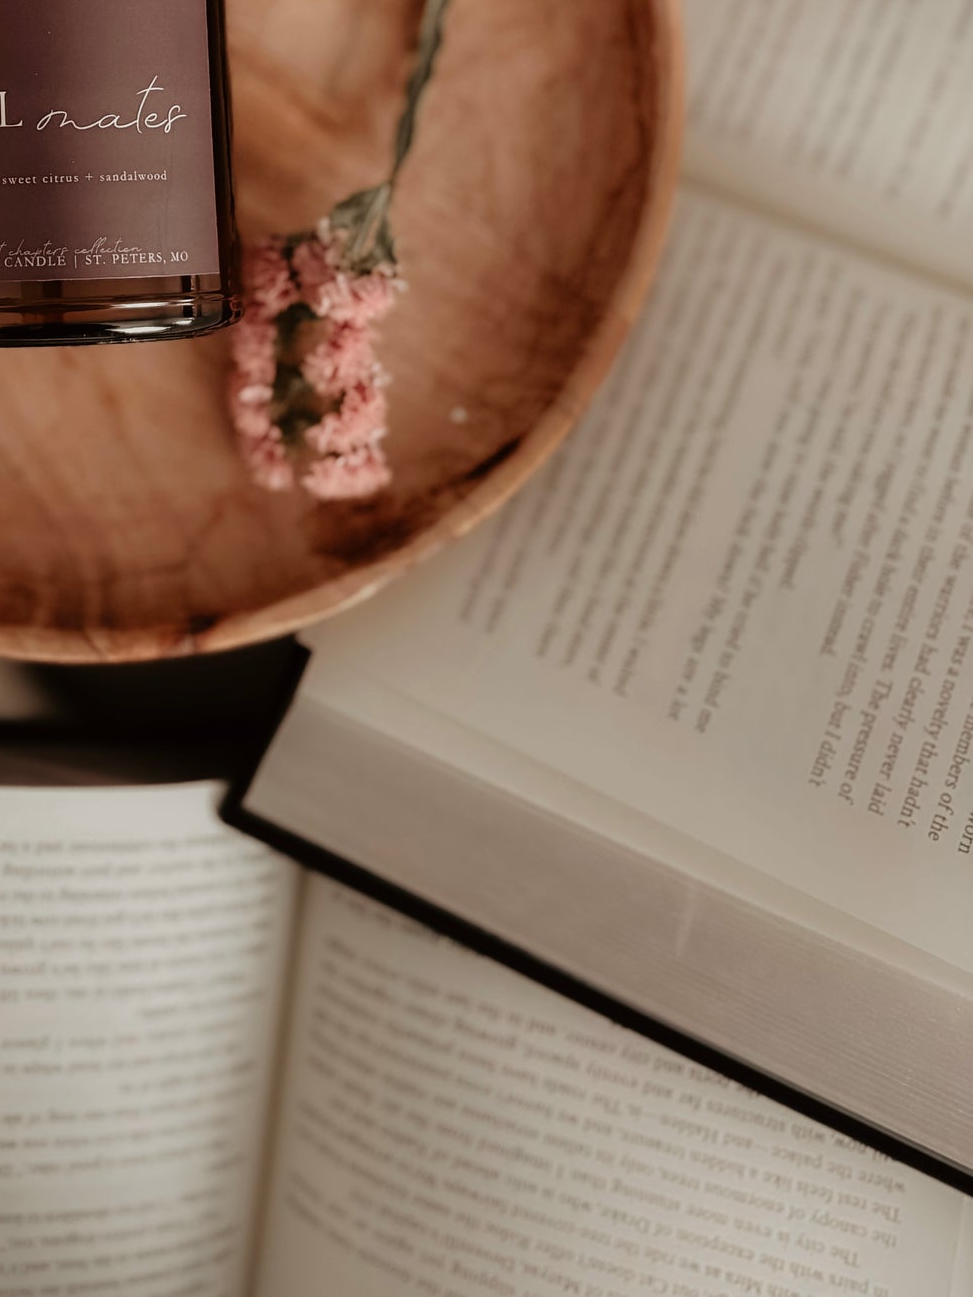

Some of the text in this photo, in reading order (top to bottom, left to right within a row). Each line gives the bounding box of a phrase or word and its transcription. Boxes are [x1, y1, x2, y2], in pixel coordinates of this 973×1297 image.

[36, 75, 187, 134] mates
[2, 175, 37, 185] sweet
[42, 172, 79, 184] citrus
[99, 170, 167, 182] sandalwood
[4, 255, 67, 268] CANDLE
[85, 254, 106, 266] ST.
[112, 252, 166, 265] PETERS,
[170, 250, 189, 262] MO
[74, 237, 142, 255] collection
[827, 701, 851, 729] but
[892, 676, 924, 730] clearly
[923, 679, 955, 740] novelty
[837, 680, 893, 806] The pressure of
[879, 732, 903, 780] never
[914, 741, 938, 775] that
[867, 782, 892, 816] laid
[937, 792, 954, 816] of
[927, 813, 949, 841] the
